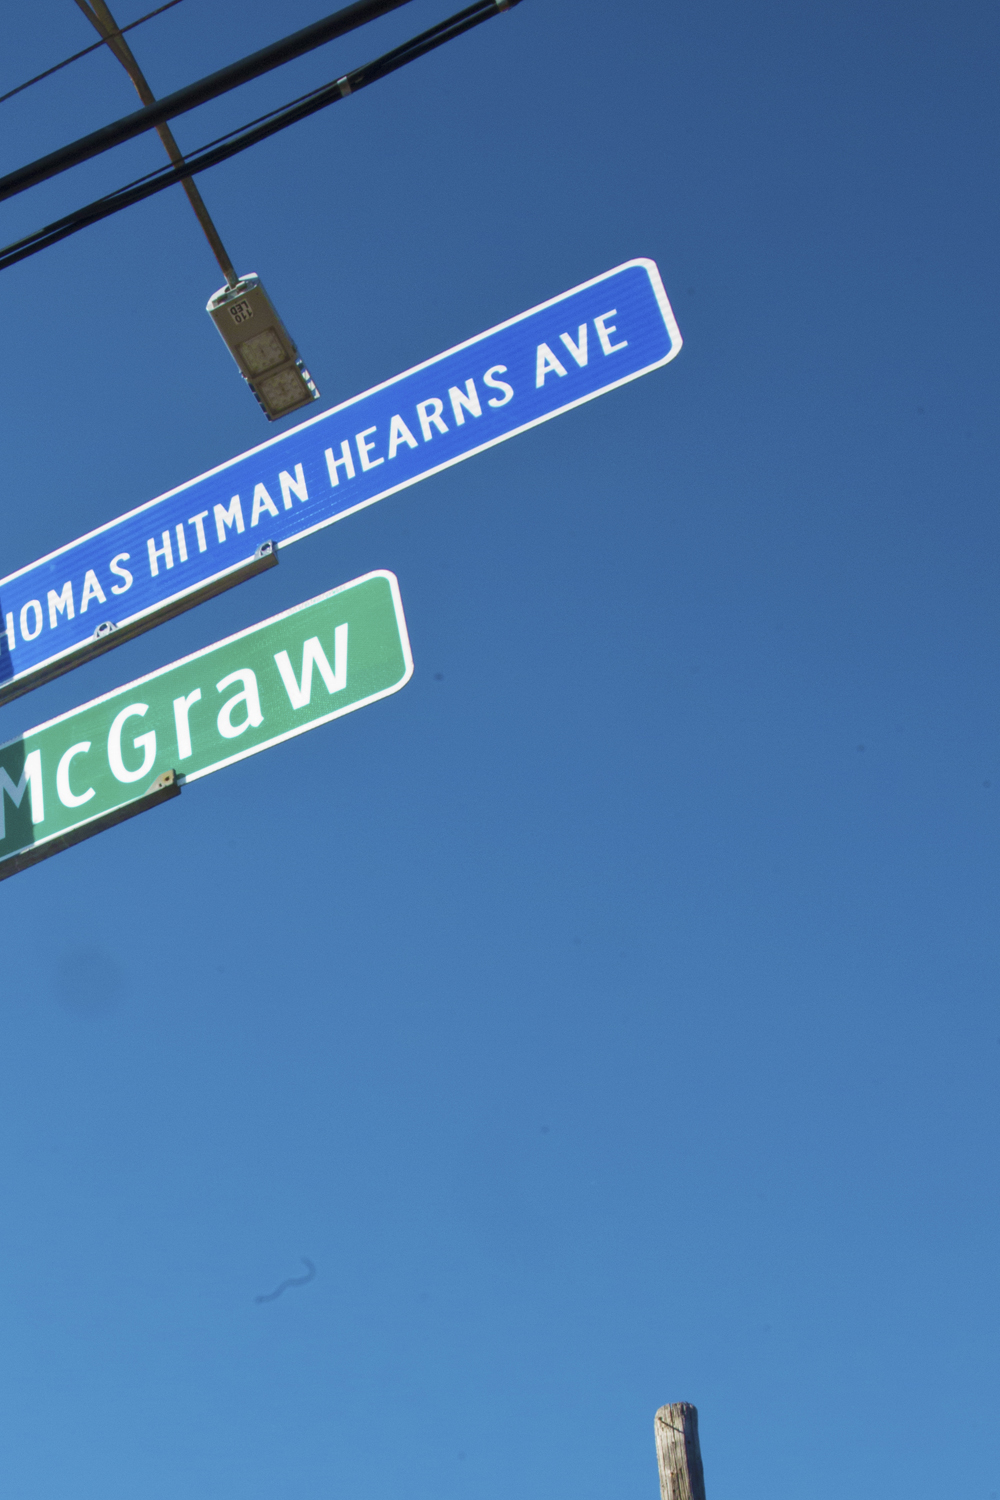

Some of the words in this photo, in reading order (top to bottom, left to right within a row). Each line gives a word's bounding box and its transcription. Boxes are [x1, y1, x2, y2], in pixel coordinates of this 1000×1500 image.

[230, 300, 249, 315] LED
[235, 309, 252, 323] 110
[146, 462, 309, 579] HITMAN
[324, 363, 514, 488] HEARNS
[533, 308, 629, 389] AVE
